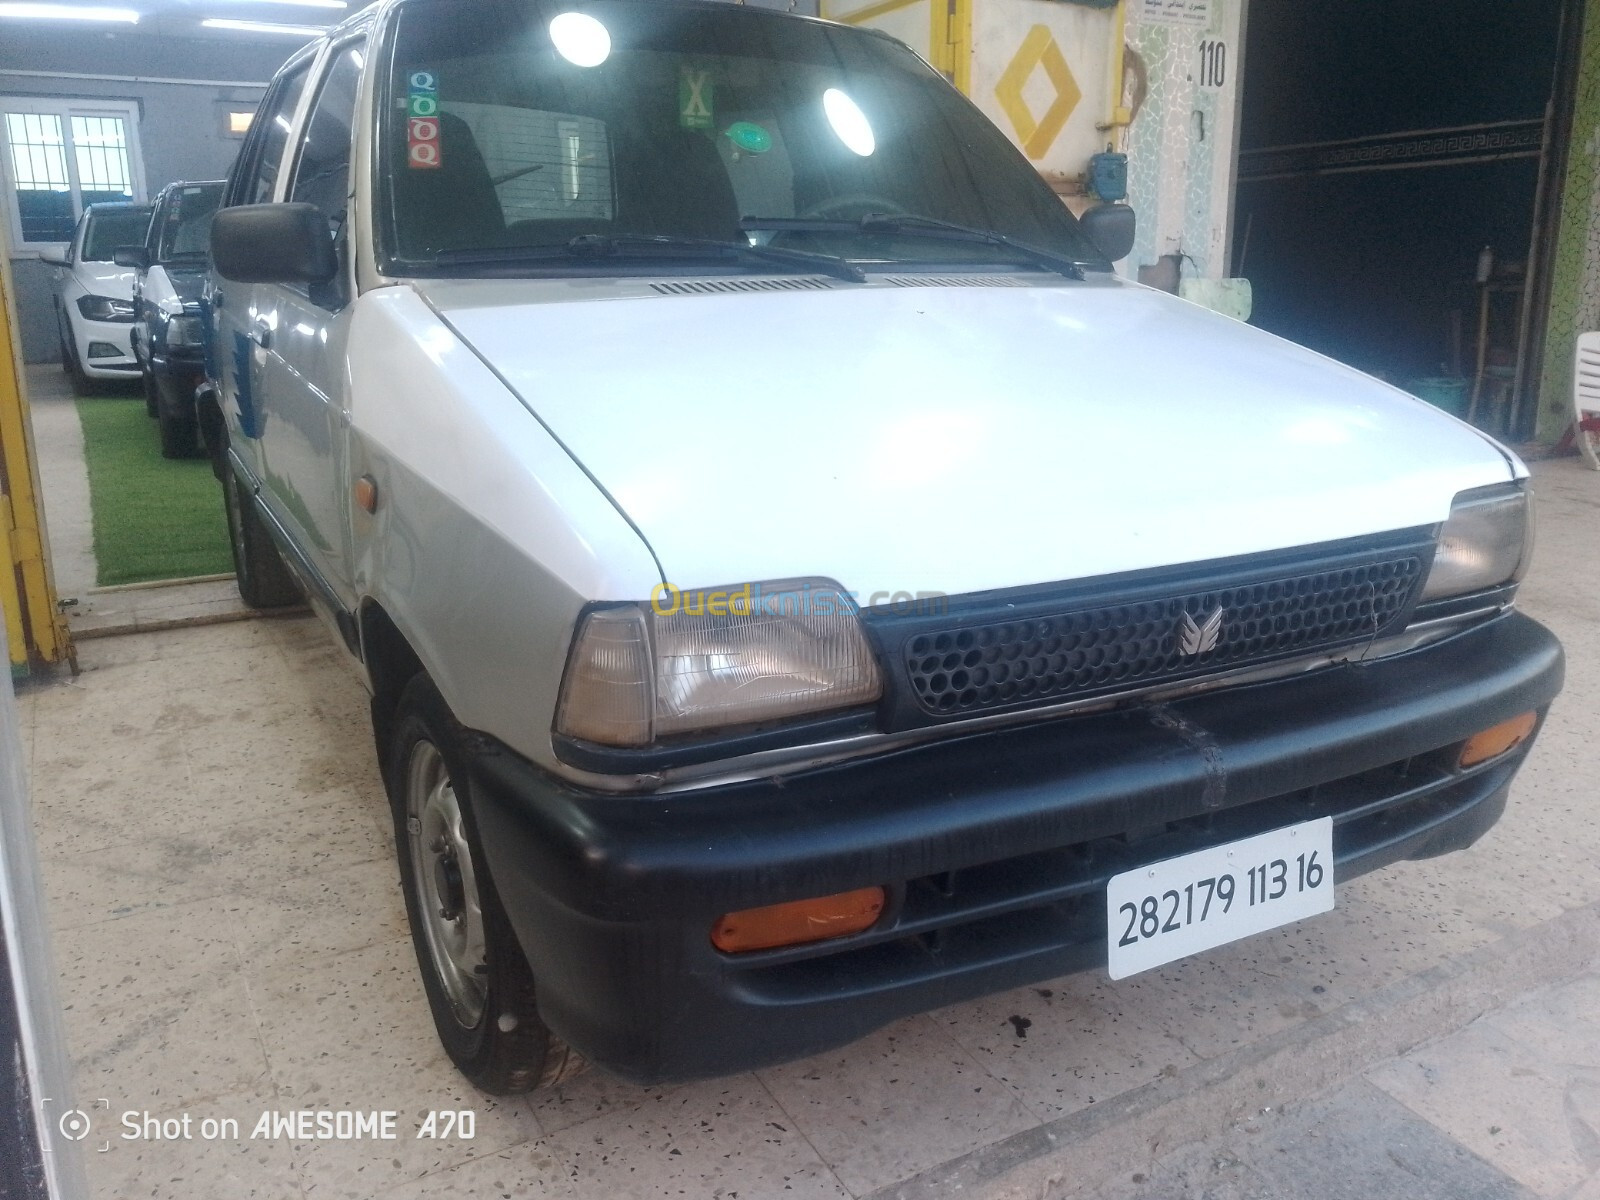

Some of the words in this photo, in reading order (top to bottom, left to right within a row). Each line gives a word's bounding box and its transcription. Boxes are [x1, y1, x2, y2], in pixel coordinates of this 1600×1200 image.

[1198, 40, 1225, 87] 110
[1118, 873, 1236, 948] 282179
[1247, 858, 1288, 907] 113
[1296, 849, 1325, 893] 16
